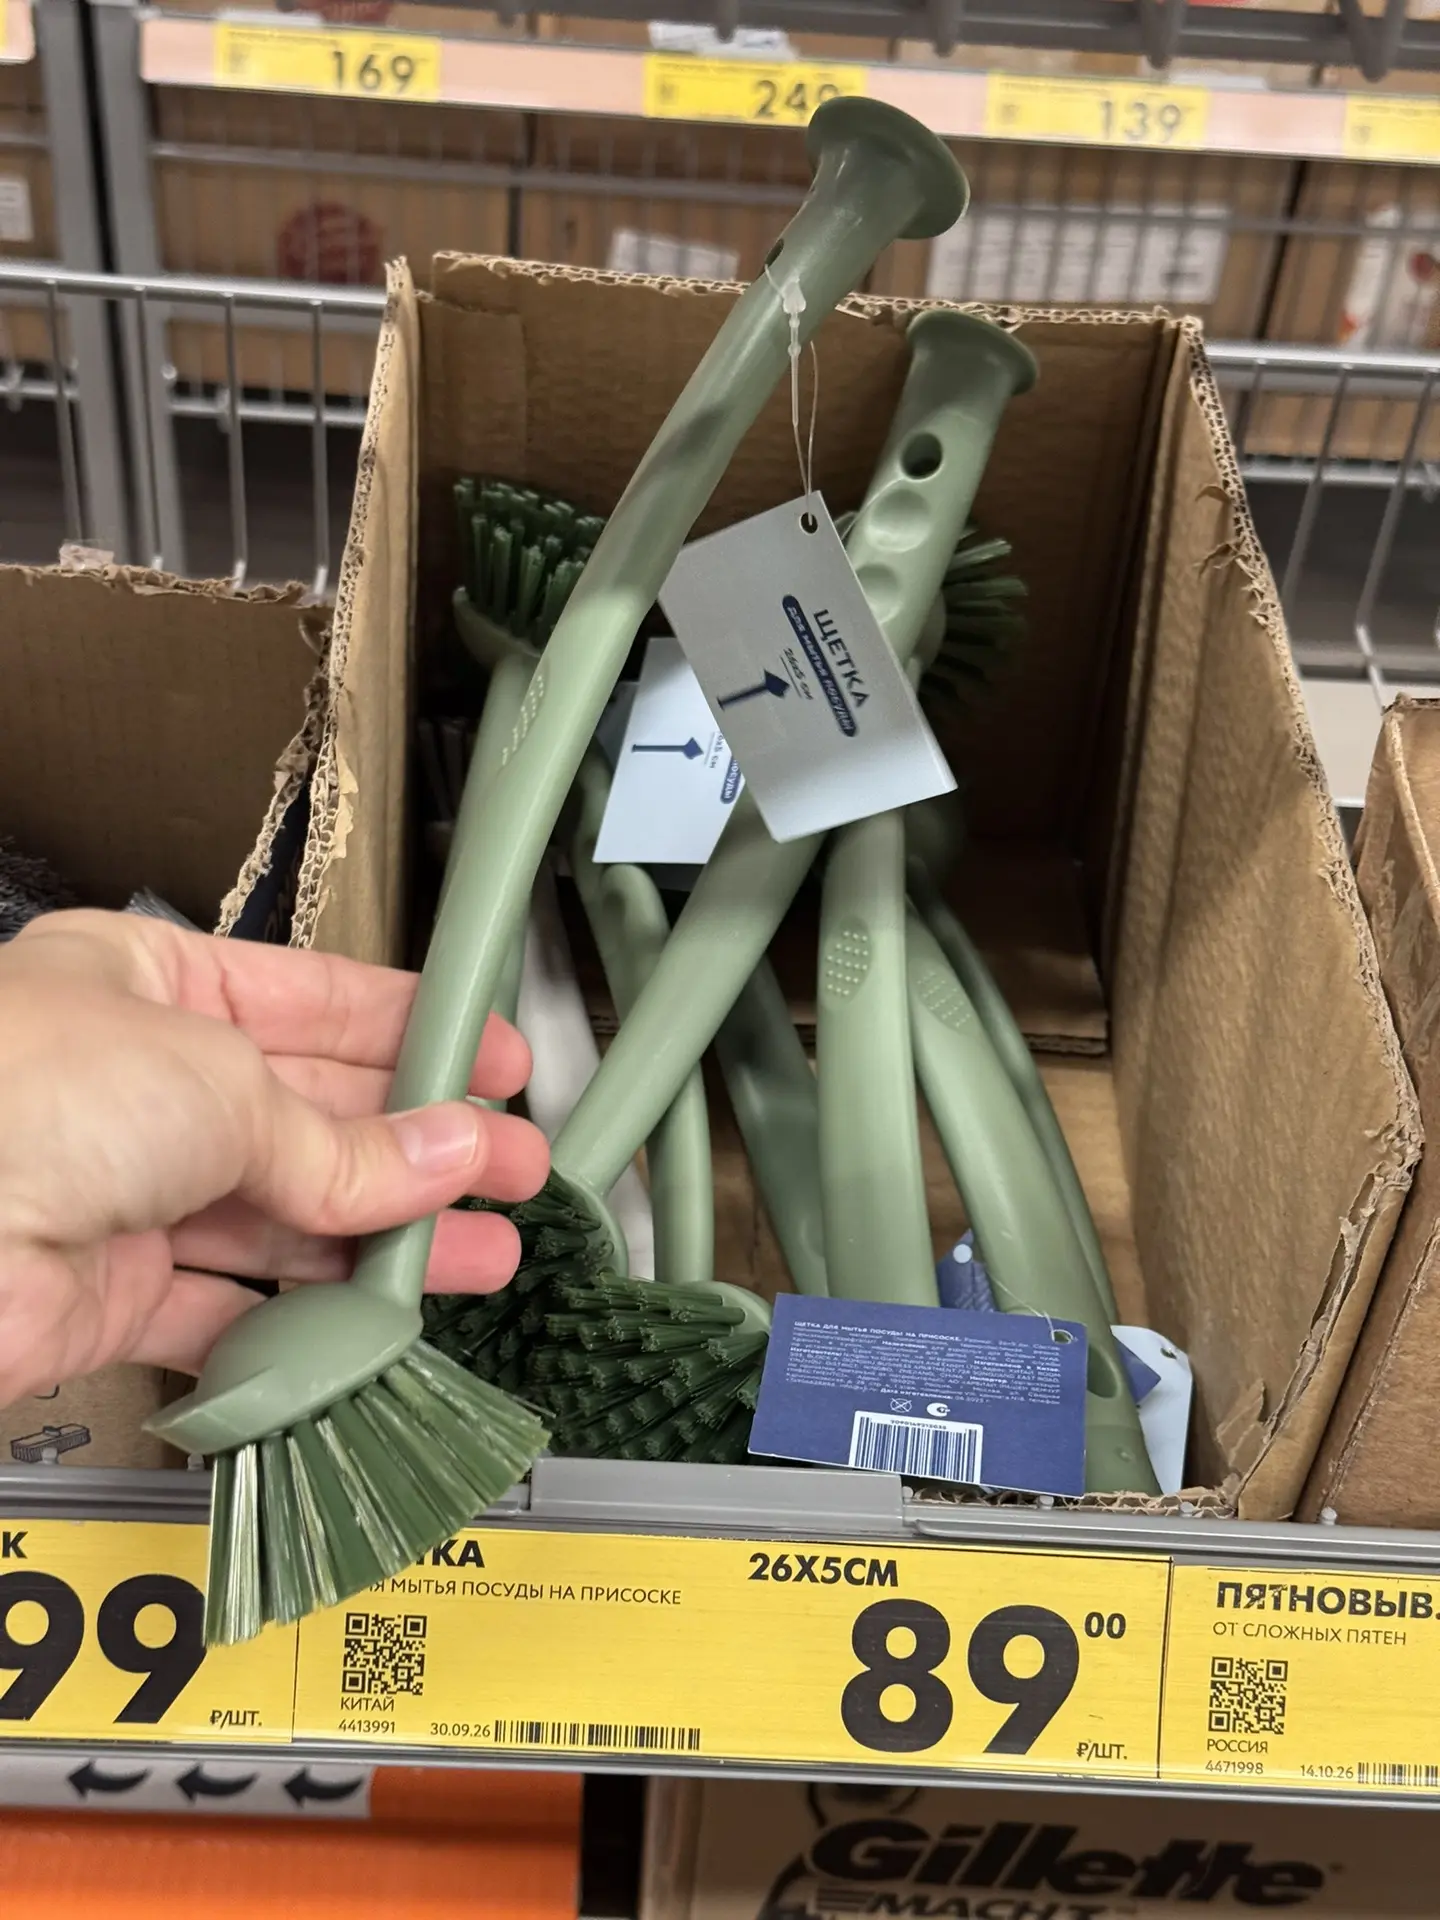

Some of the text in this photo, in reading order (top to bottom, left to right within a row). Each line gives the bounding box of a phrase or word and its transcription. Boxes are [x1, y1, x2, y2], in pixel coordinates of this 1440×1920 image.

[332, 51, 425, 94] 169
[1101, 100, 1182, 142] 139
[813, 609, 870, 708] ЩЕТКА
[794, 1321, 820, 1329] ЩЕТКА
[869, 1328, 903, 1337] ПОСУДЫ
[748, 1552, 899, 1587] 26Х5СМ
[391, 1578, 456, 1595] МЫТЬЯ
[462, 1581, 543, 1600] ПОСУДЫ
[549, 1585, 575, 1600] НА
[581, 1586, 681, 1605] ПРИСОСКЕ
[1216, 1581, 1440, 1621] ПЯТНОВЫВ.
[1085, 1612, 1126, 1639] 00
[1213, 1621, 1407, 1646] ОТ СЛОЖНЫХ ПЯТЕН
[0, 1571, 207, 1724] 99
[840, 1598, 1080, 1756] 89
[340, 1696, 395, 1713] КИТАЙ
[338, 1719, 396, 1734] 4413991
[430, 1722, 491, 1738] 30.09.26
[1207, 1738, 1268, 1754] РОССИЯ
[1205, 1760, 1264, 1775] 4471998
[1300, 1763, 1354, 1779] 14.10.26
[811, 1818, 1325, 1908] Gillette
